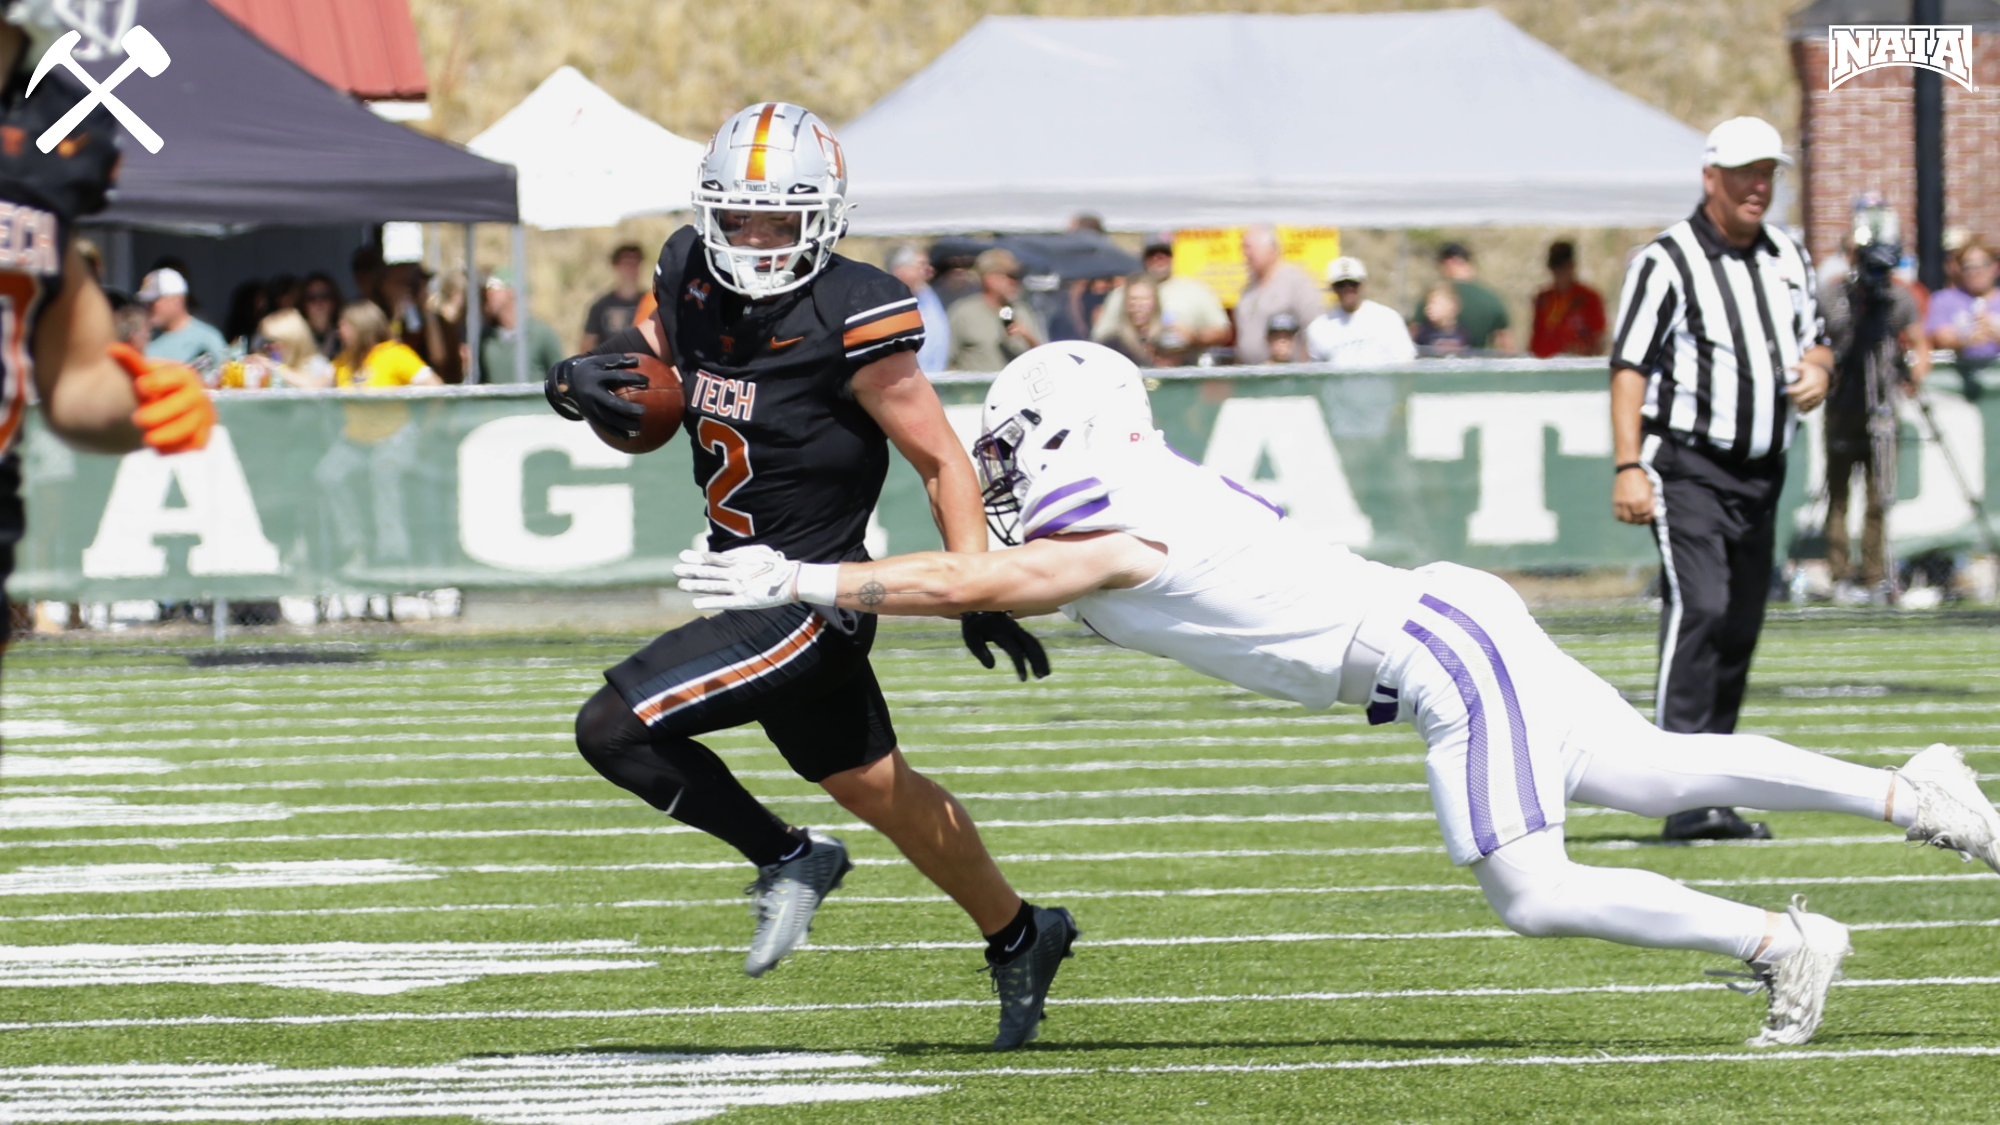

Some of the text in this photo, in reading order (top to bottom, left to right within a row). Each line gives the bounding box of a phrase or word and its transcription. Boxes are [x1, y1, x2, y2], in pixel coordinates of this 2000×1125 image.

[691, 369, 756, 421] TECH
[81, 420, 281, 578] A
[456, 391, 1616, 572] GAT
[697, 416, 755, 538] 2
